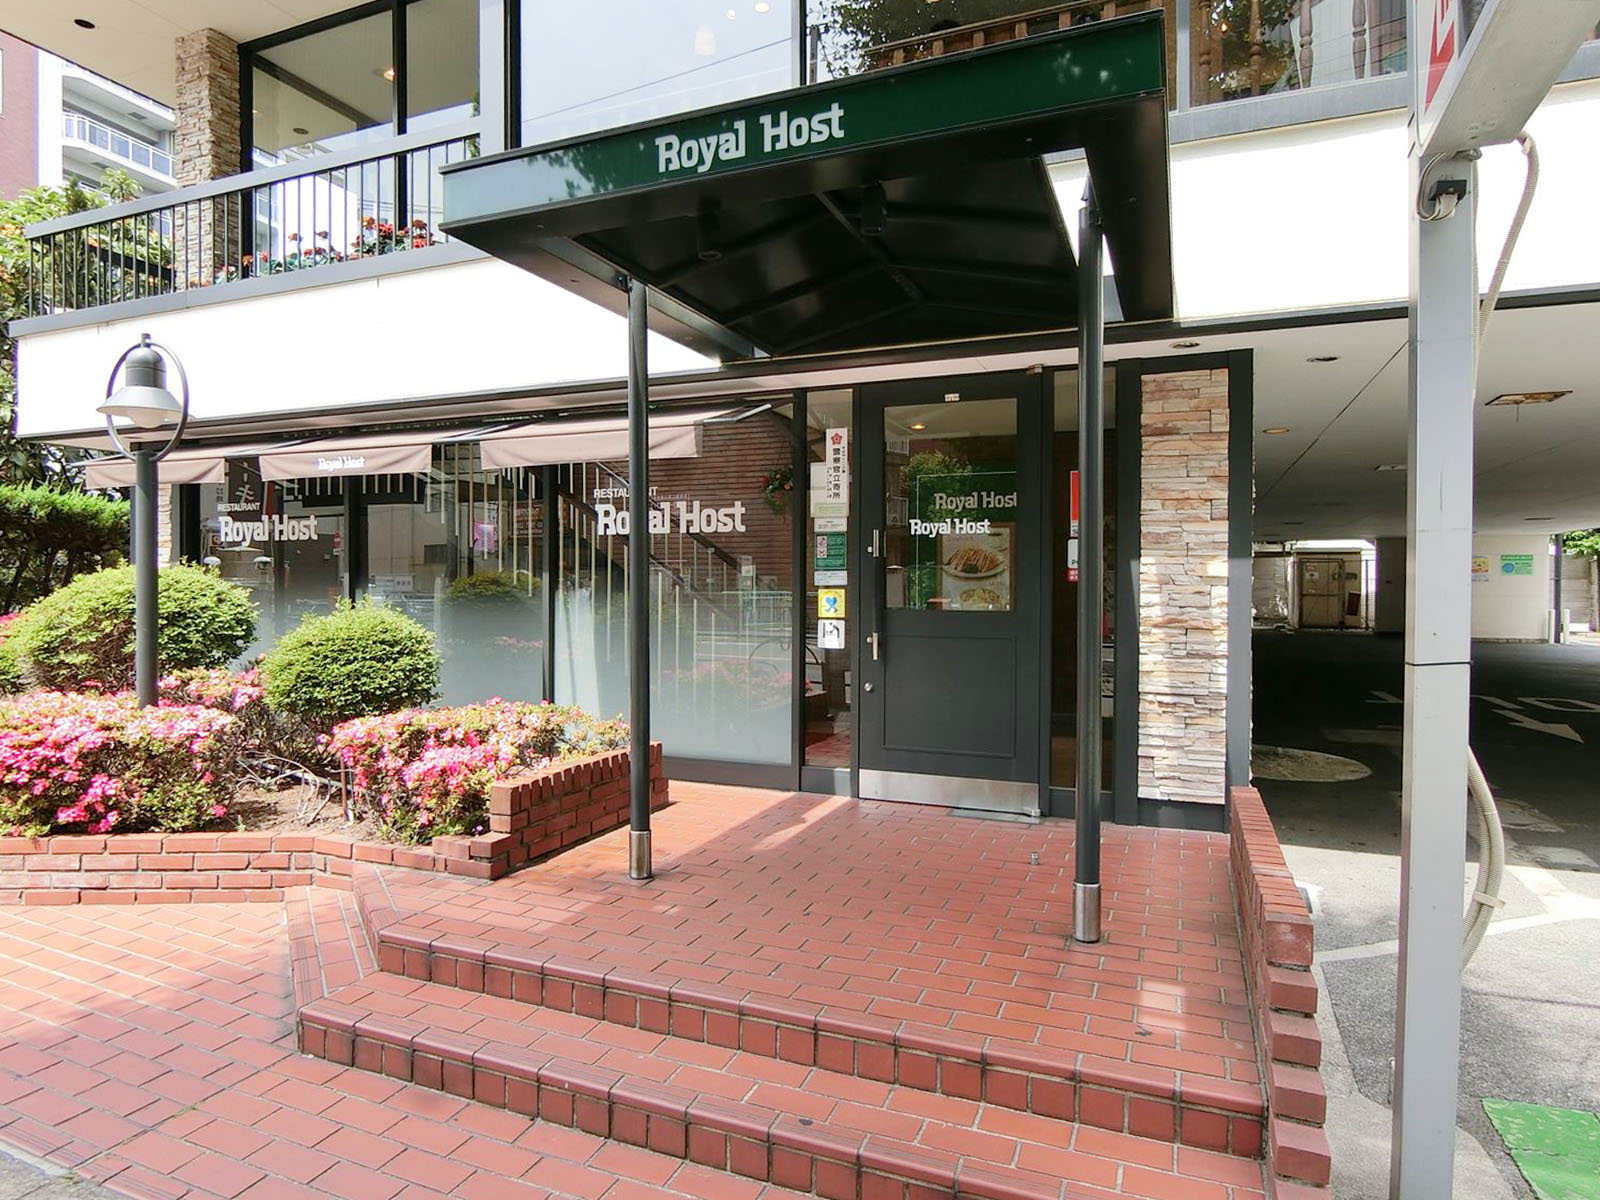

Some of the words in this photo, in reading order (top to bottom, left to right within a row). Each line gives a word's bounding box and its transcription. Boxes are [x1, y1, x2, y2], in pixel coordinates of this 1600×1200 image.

[654, 119, 746, 173] Royal
[759, 102, 845, 153] Host
[318, 456, 342, 471] Royal
[343, 456, 365, 468] Host
[832, 448, 841, 498] 警察官立寄所
[594, 487, 657, 498] RESTAUT
[934, 493, 977, 512] Royal
[218, 503, 261, 512] RESTAURANT
[595, 501, 671, 536] Roal
[676, 500, 746, 533] Host
[909, 518, 952, 538] Royal
[953, 518, 991, 535] Host
[218, 514, 269, 547] Royal
[272, 514, 318, 541] Host
